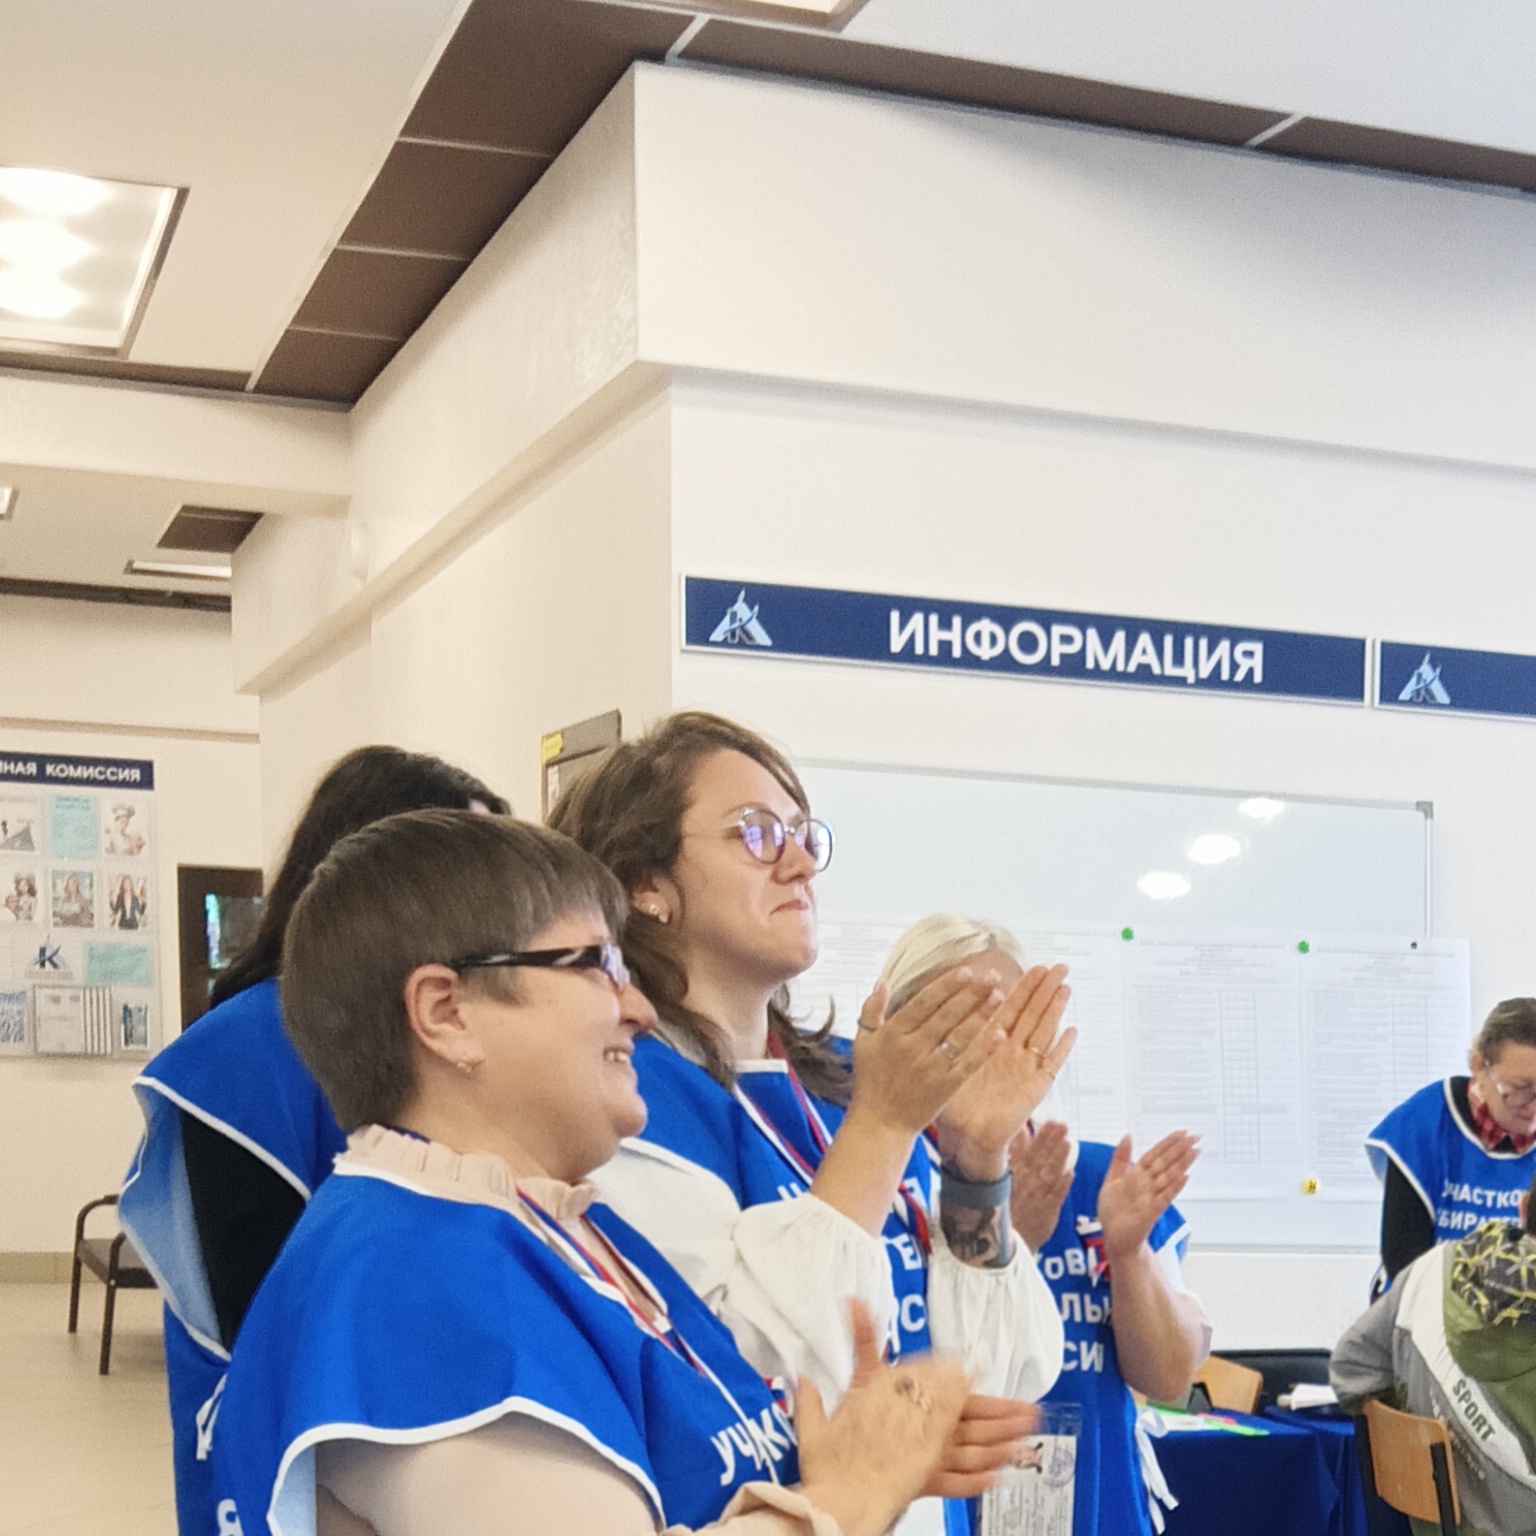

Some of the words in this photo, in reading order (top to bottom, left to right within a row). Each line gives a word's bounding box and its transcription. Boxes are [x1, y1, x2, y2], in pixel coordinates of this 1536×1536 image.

[888, 609, 1264, 683] ИНФОРМАЦИЯ
[0, 760, 37, 776] НАЯ
[45, 762, 141, 782] КОМИССИЯ
[1441, 1183, 1524, 1208] УЧАСТКО
[1452, 1378, 1496, 1441] SPORT
